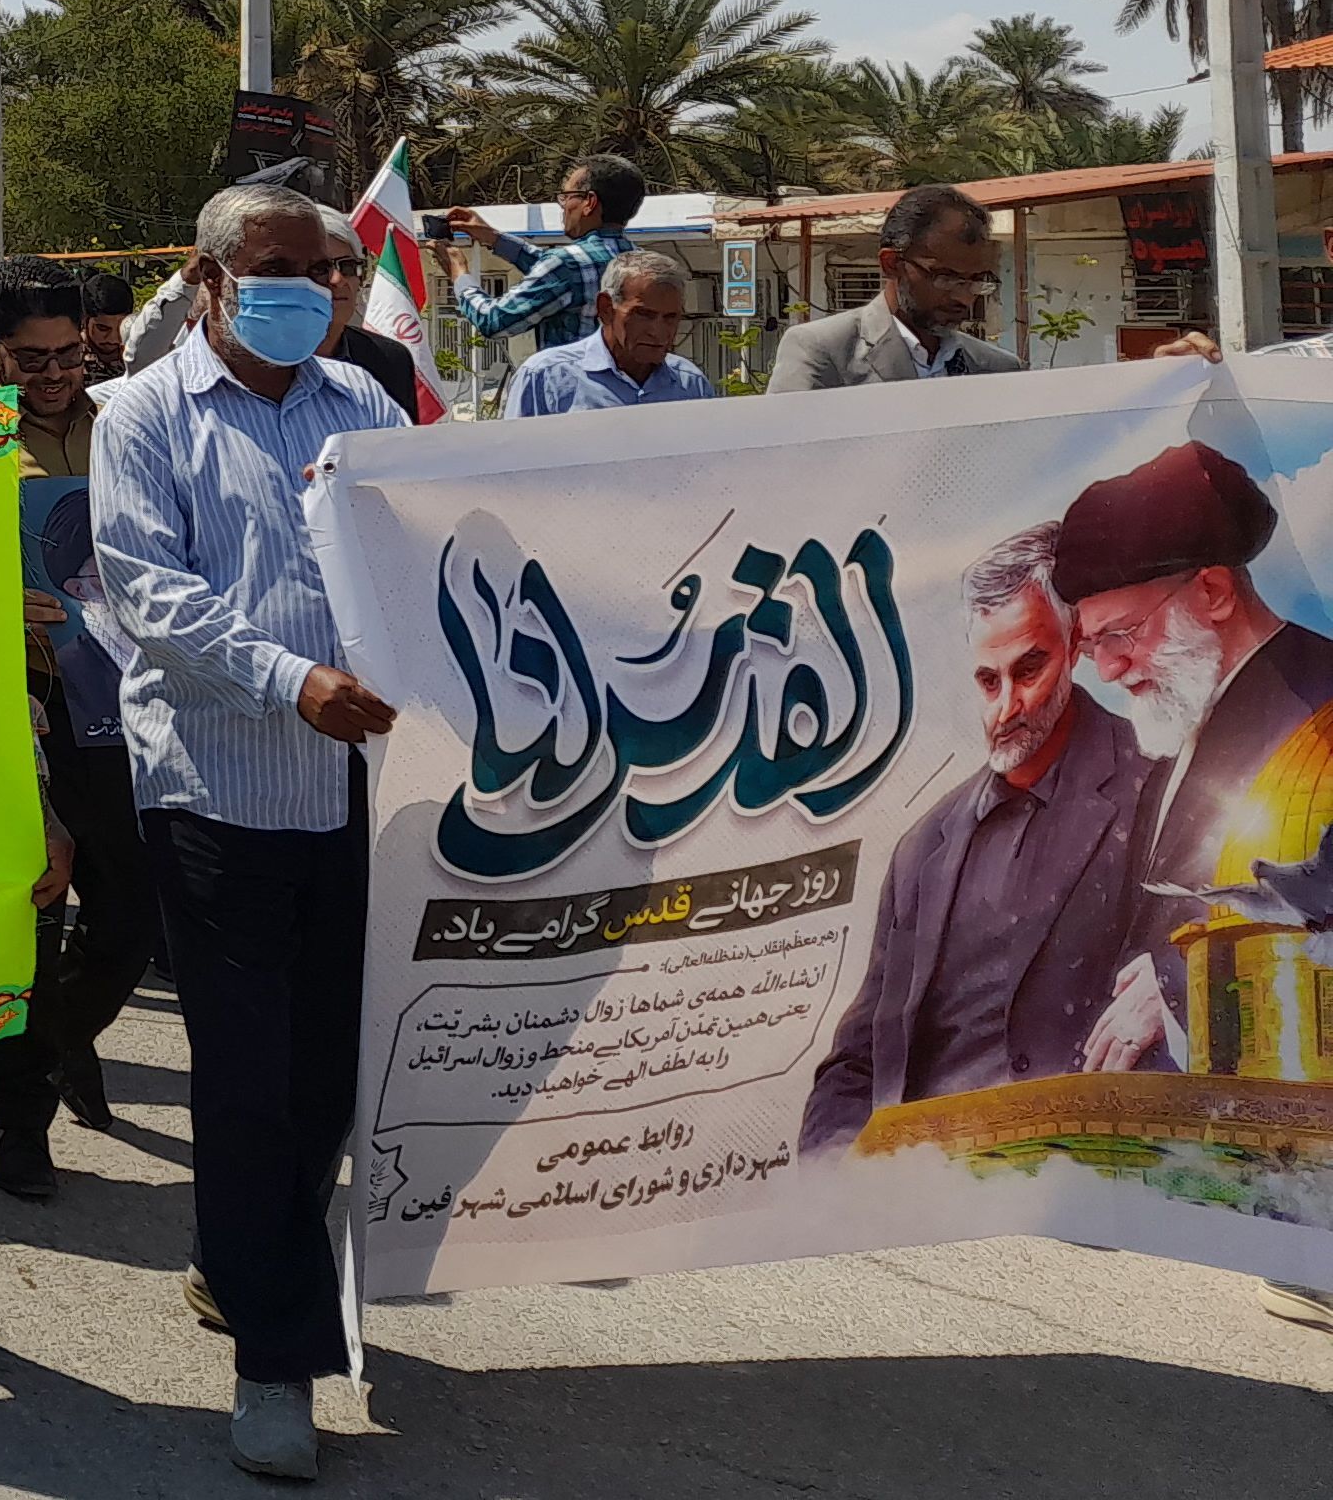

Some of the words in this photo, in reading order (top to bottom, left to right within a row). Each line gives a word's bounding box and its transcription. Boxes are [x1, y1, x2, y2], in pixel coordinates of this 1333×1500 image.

[688, 873, 791, 930] جهانی
[791, 864, 841, 909] روز
[492, 893, 609, 953] گرامی
[604, 884, 693, 943] قدس
[584, 996, 624, 1023] زوال
[630, 988, 685, 1015] شماها
[767, 1003, 812, 1027] یعنی
[505, 1007, 580, 1035] دشمنان
[717, 1011, 768, 1039] همین
[408, 1045, 483, 1071] اسرائیل
[483, 1046, 524, 1071] زوال
[648, 1050, 696, 1077] لطف
[695, 1053, 714, 1072] به
[715, 1046, 730, 1069] را
[533, 1068, 603, 1100] خواهید
[638, 1117, 695, 1154] روابط
[536, 1137, 630, 1174] عمومی
[693, 1140, 791, 1193] شهرداری
[599, 1166, 675, 1211] شورای
[677, 1167, 691, 1196] و
[400, 1183, 453, 1222] فین
[450, 1187, 506, 1221] شهر
[506, 1179, 599, 1219] اسلامی
